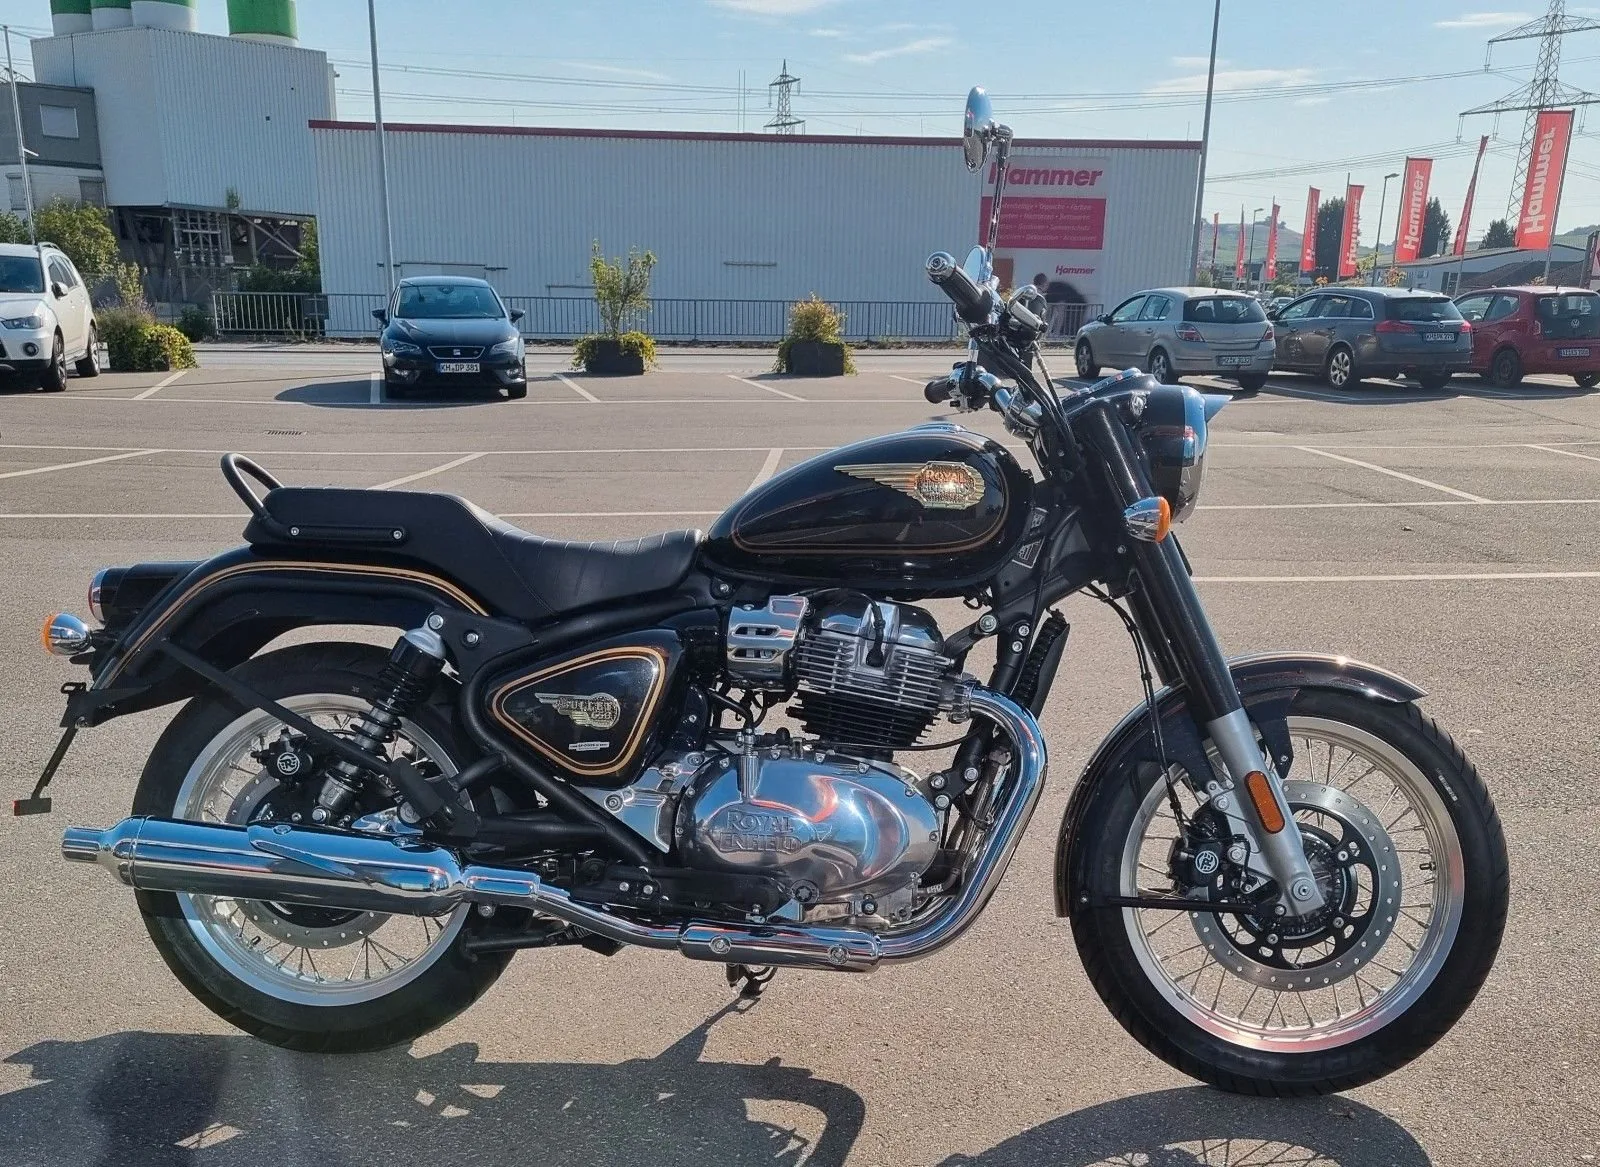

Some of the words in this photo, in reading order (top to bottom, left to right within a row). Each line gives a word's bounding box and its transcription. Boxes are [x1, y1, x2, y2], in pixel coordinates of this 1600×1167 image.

[1403, 170, 1425, 250] Hammer
[1055, 265, 1096, 276] Hammer
[925, 469, 966, 482] ROYAL
[726, 811, 794, 833] ROYAL
[720, 832, 802, 854] ENFIELD
